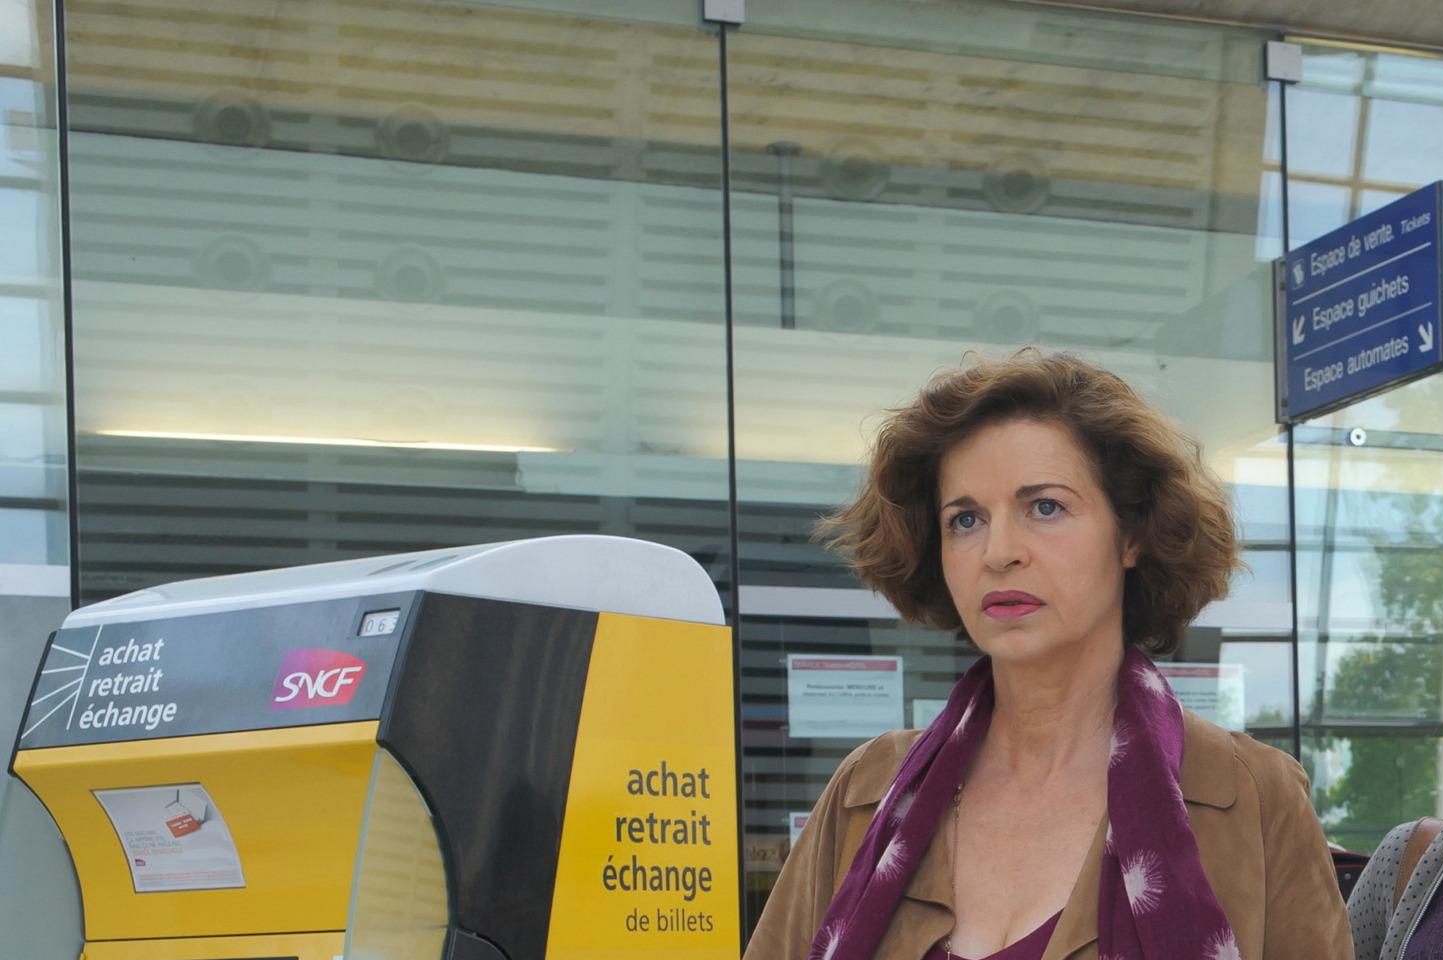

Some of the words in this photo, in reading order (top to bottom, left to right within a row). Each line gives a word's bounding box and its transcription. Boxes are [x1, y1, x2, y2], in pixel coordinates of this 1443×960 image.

[1310, 245, 1346, 276] Espace
[1347, 235, 1361, 259] de
[1400, 212, 1431, 234] Tickets
[1312, 298, 1354, 331] Espace
[1357, 275, 1409, 317] guichets
[1304, 361, 1344, 391] Espace
[1347, 335, 1409, 375] automates
[98, 638, 165, 666] achat
[87, 666, 164, 697] retrait
[274, 665, 362, 702] SNCF
[79, 700, 178, 731] échange
[627, 760, 711, 799] achat
[615, 810, 712, 846] retrait
[602, 855, 713, 901] échange
[626, 908, 650, 932] de
[657, 908, 714, 932] billets
